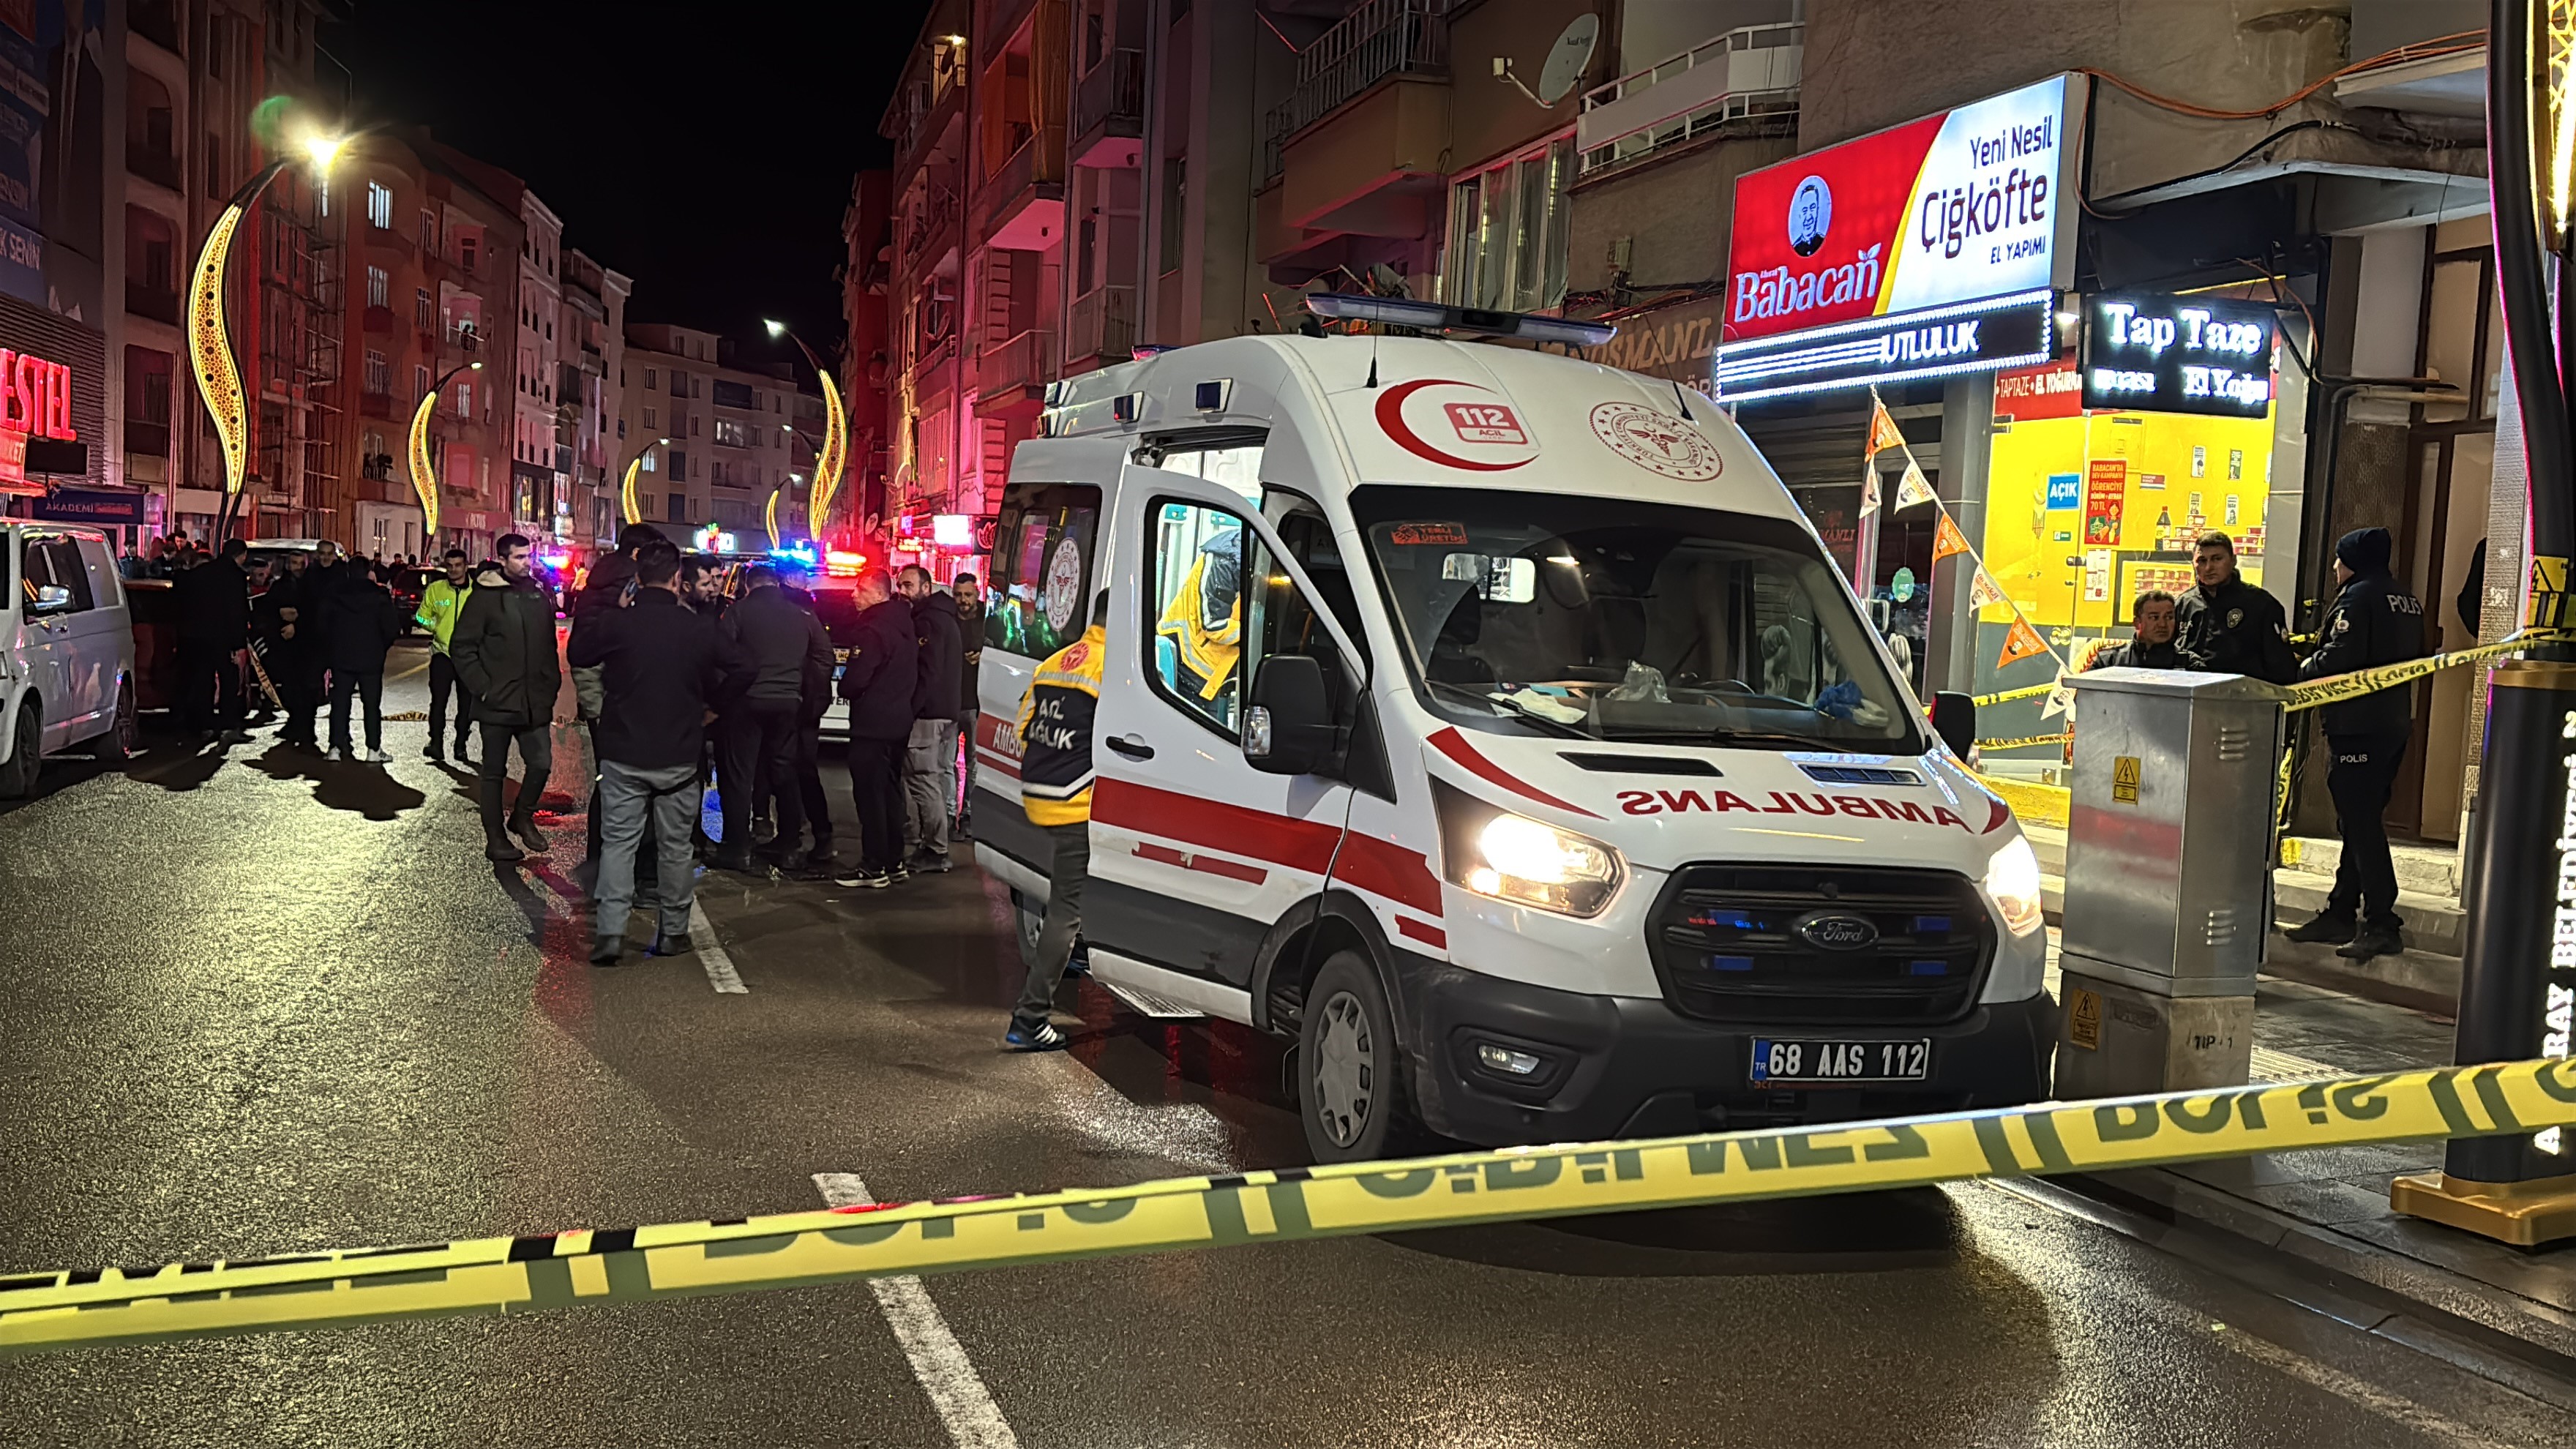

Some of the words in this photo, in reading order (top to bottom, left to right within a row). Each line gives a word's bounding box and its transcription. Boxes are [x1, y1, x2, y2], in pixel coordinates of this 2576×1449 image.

[1970, 129, 2007, 170] Yeni
[2011, 114, 2053, 159] Nesil
[1922, 168, 2048, 259] Çiğköfte
[1990, 245, 2002, 264] EL
[2007, 235, 2046, 261] YAPIMI
[1734, 258, 1879, 323] Babacan
[2105, 303, 2176, 353] Tap
[2179, 307, 2263, 355] Taze
[2000, 375, 2031, 398] TAPTAZE
[1455, 407, 1510, 427] 112
[2049, 482, 2078, 501] AÇIK
[1823, 921, 1863, 943] Ford
[1755, 1062, 1767, 1071] TR
[1770, 1044, 1802, 1076] 68
[1817, 1044, 1865, 1077] AAS
[1882, 1044, 1925, 1077] 112
